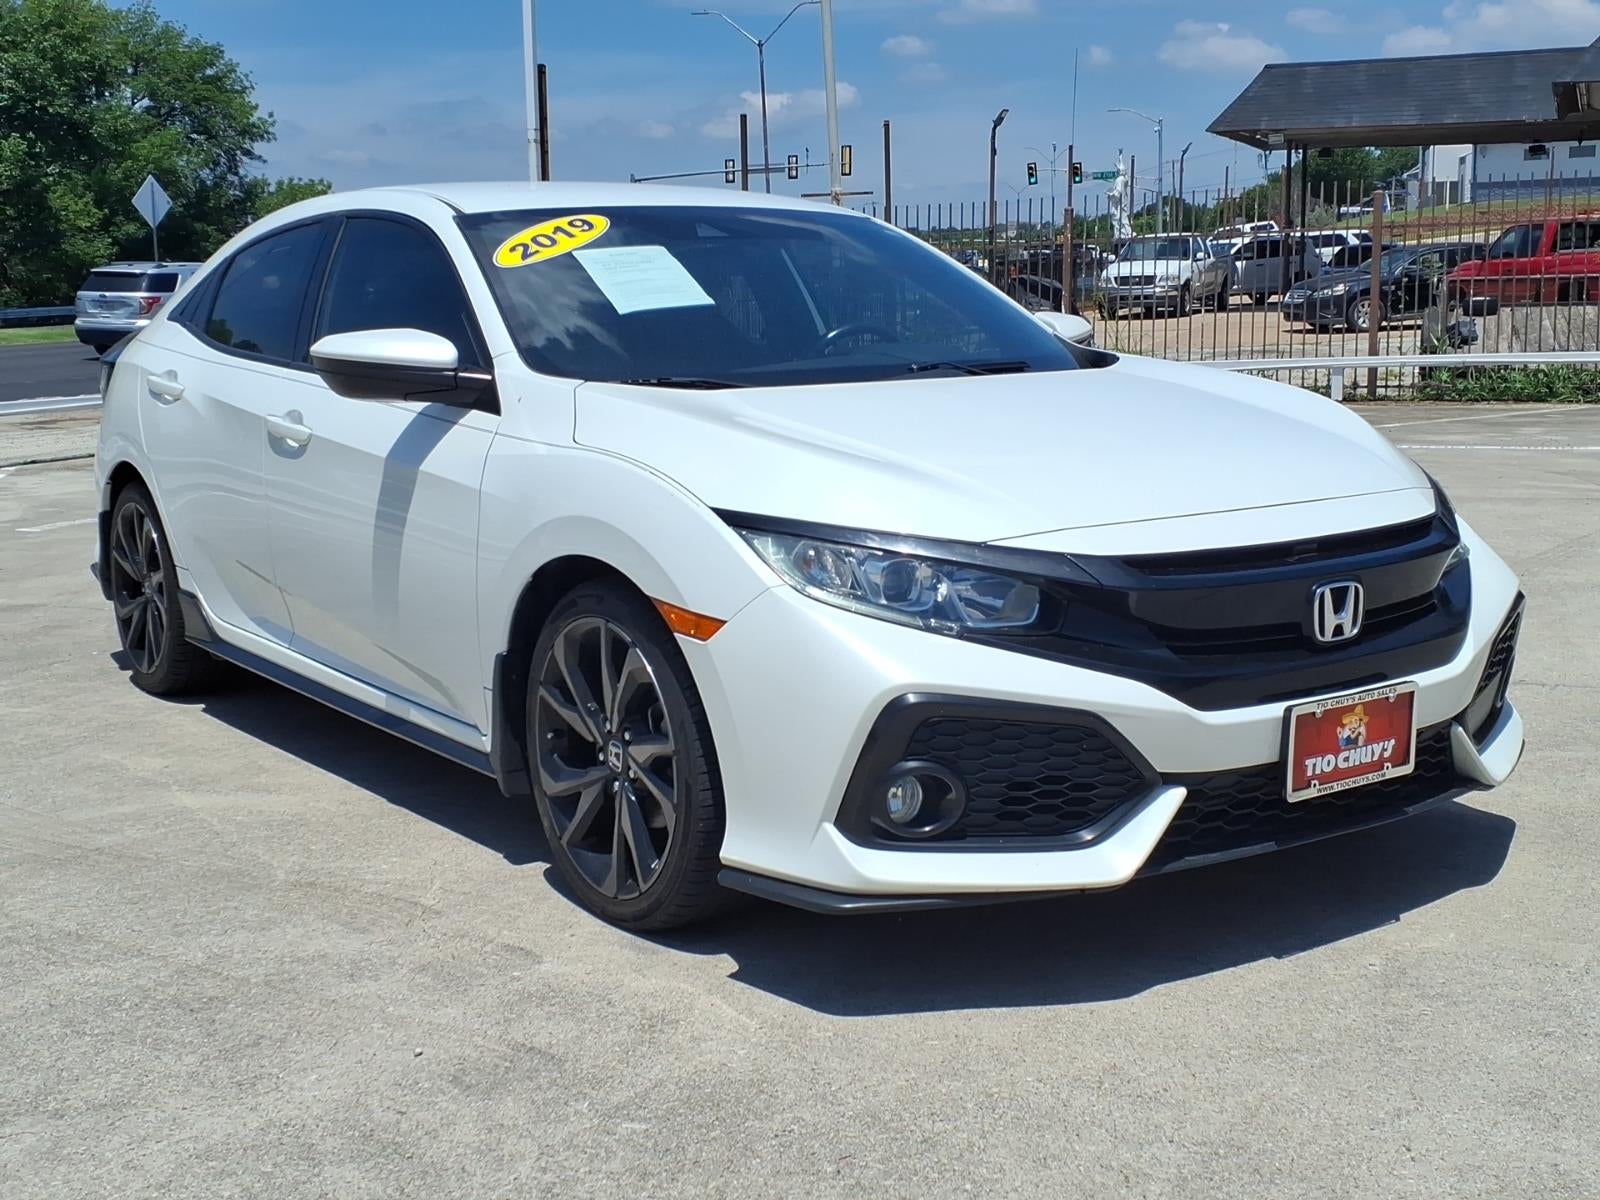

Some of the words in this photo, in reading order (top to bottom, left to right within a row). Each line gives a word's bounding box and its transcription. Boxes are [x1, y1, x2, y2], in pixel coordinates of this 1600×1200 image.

[509, 218, 594, 261] 2019
[1316, 702, 1329, 710] TIO
[1330, 697, 1356, 706] CHUY'S
[1357, 692, 1376, 702] AUTO
[1377, 687, 1398, 697] SALES
[1304, 754, 1336, 777] TIO
[1337, 738, 1396, 769] CHUY'S
[1316, 771, 1387, 794] WWW.TIOCHUYS.COM
